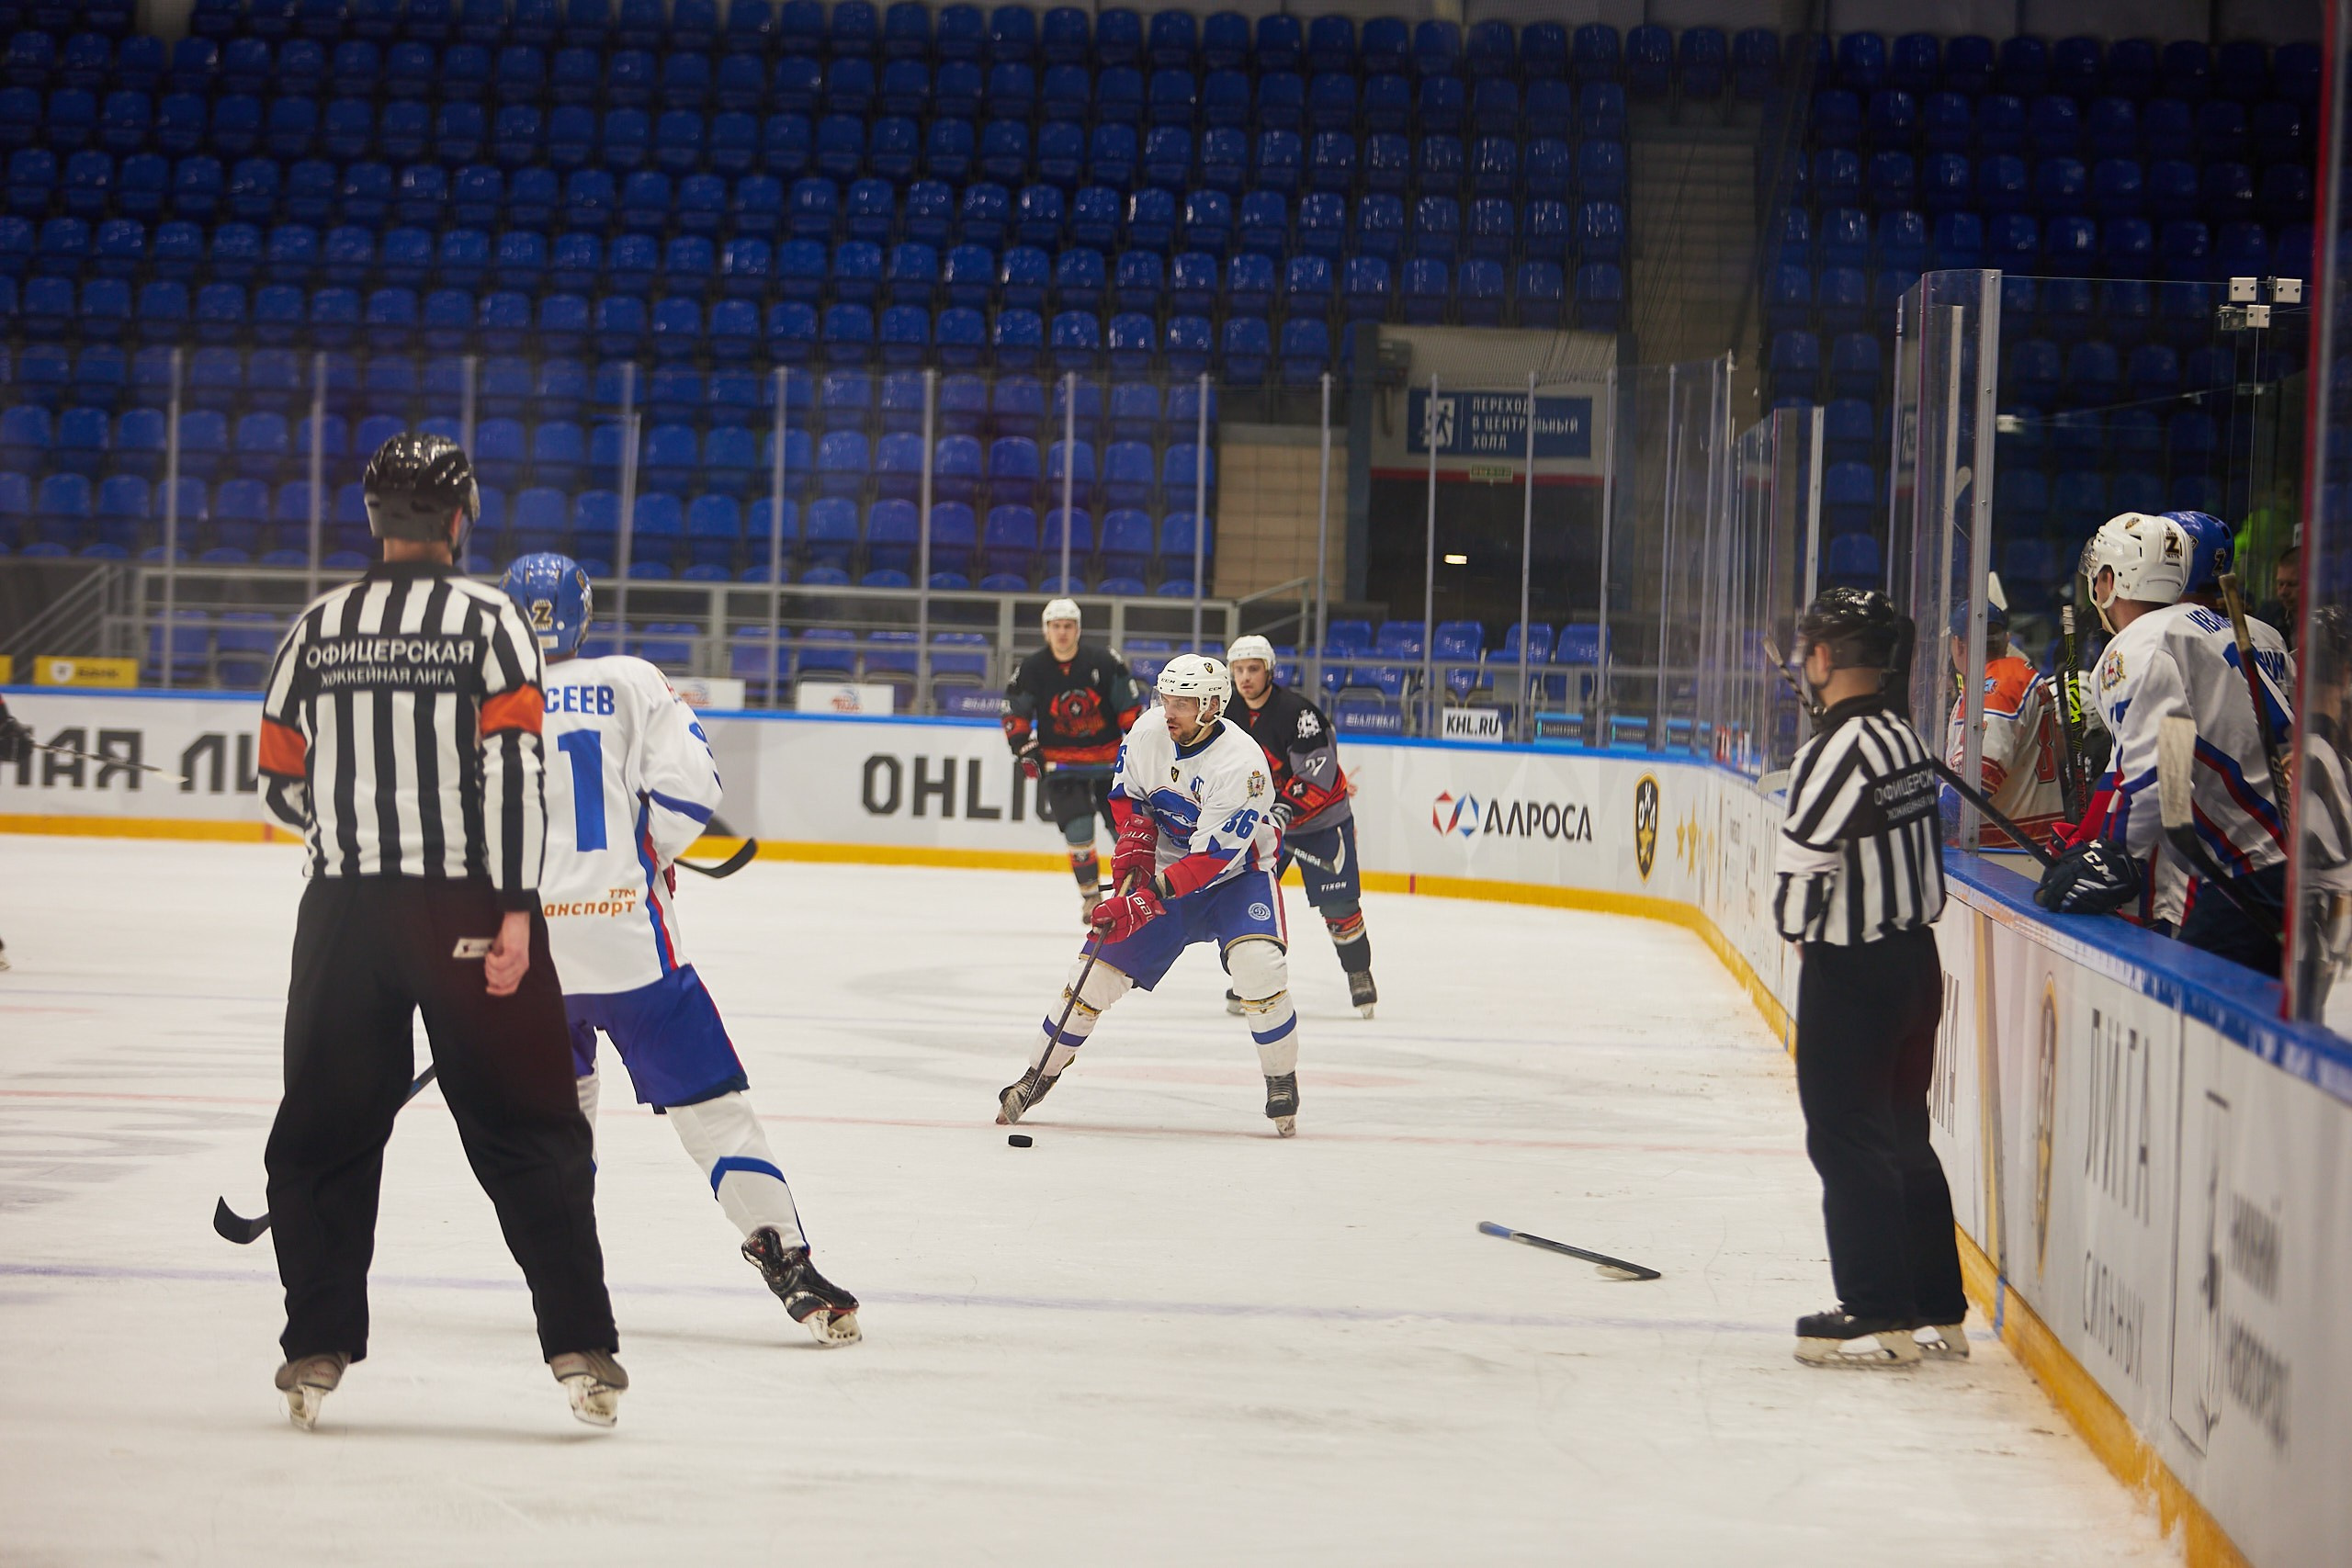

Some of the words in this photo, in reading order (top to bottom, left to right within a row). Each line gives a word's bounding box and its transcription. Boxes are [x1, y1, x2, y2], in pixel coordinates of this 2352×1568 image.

[1472, 434, 1507, 451] ХОЛЛ
[306, 638, 475, 670] ОФИЦЕРСКАЯ
[322, 666, 411, 687] ХОККЕЙНАЯ
[415, 668, 456, 686] ЛИГА
[1446, 714, 1499, 736] KHL.RU
